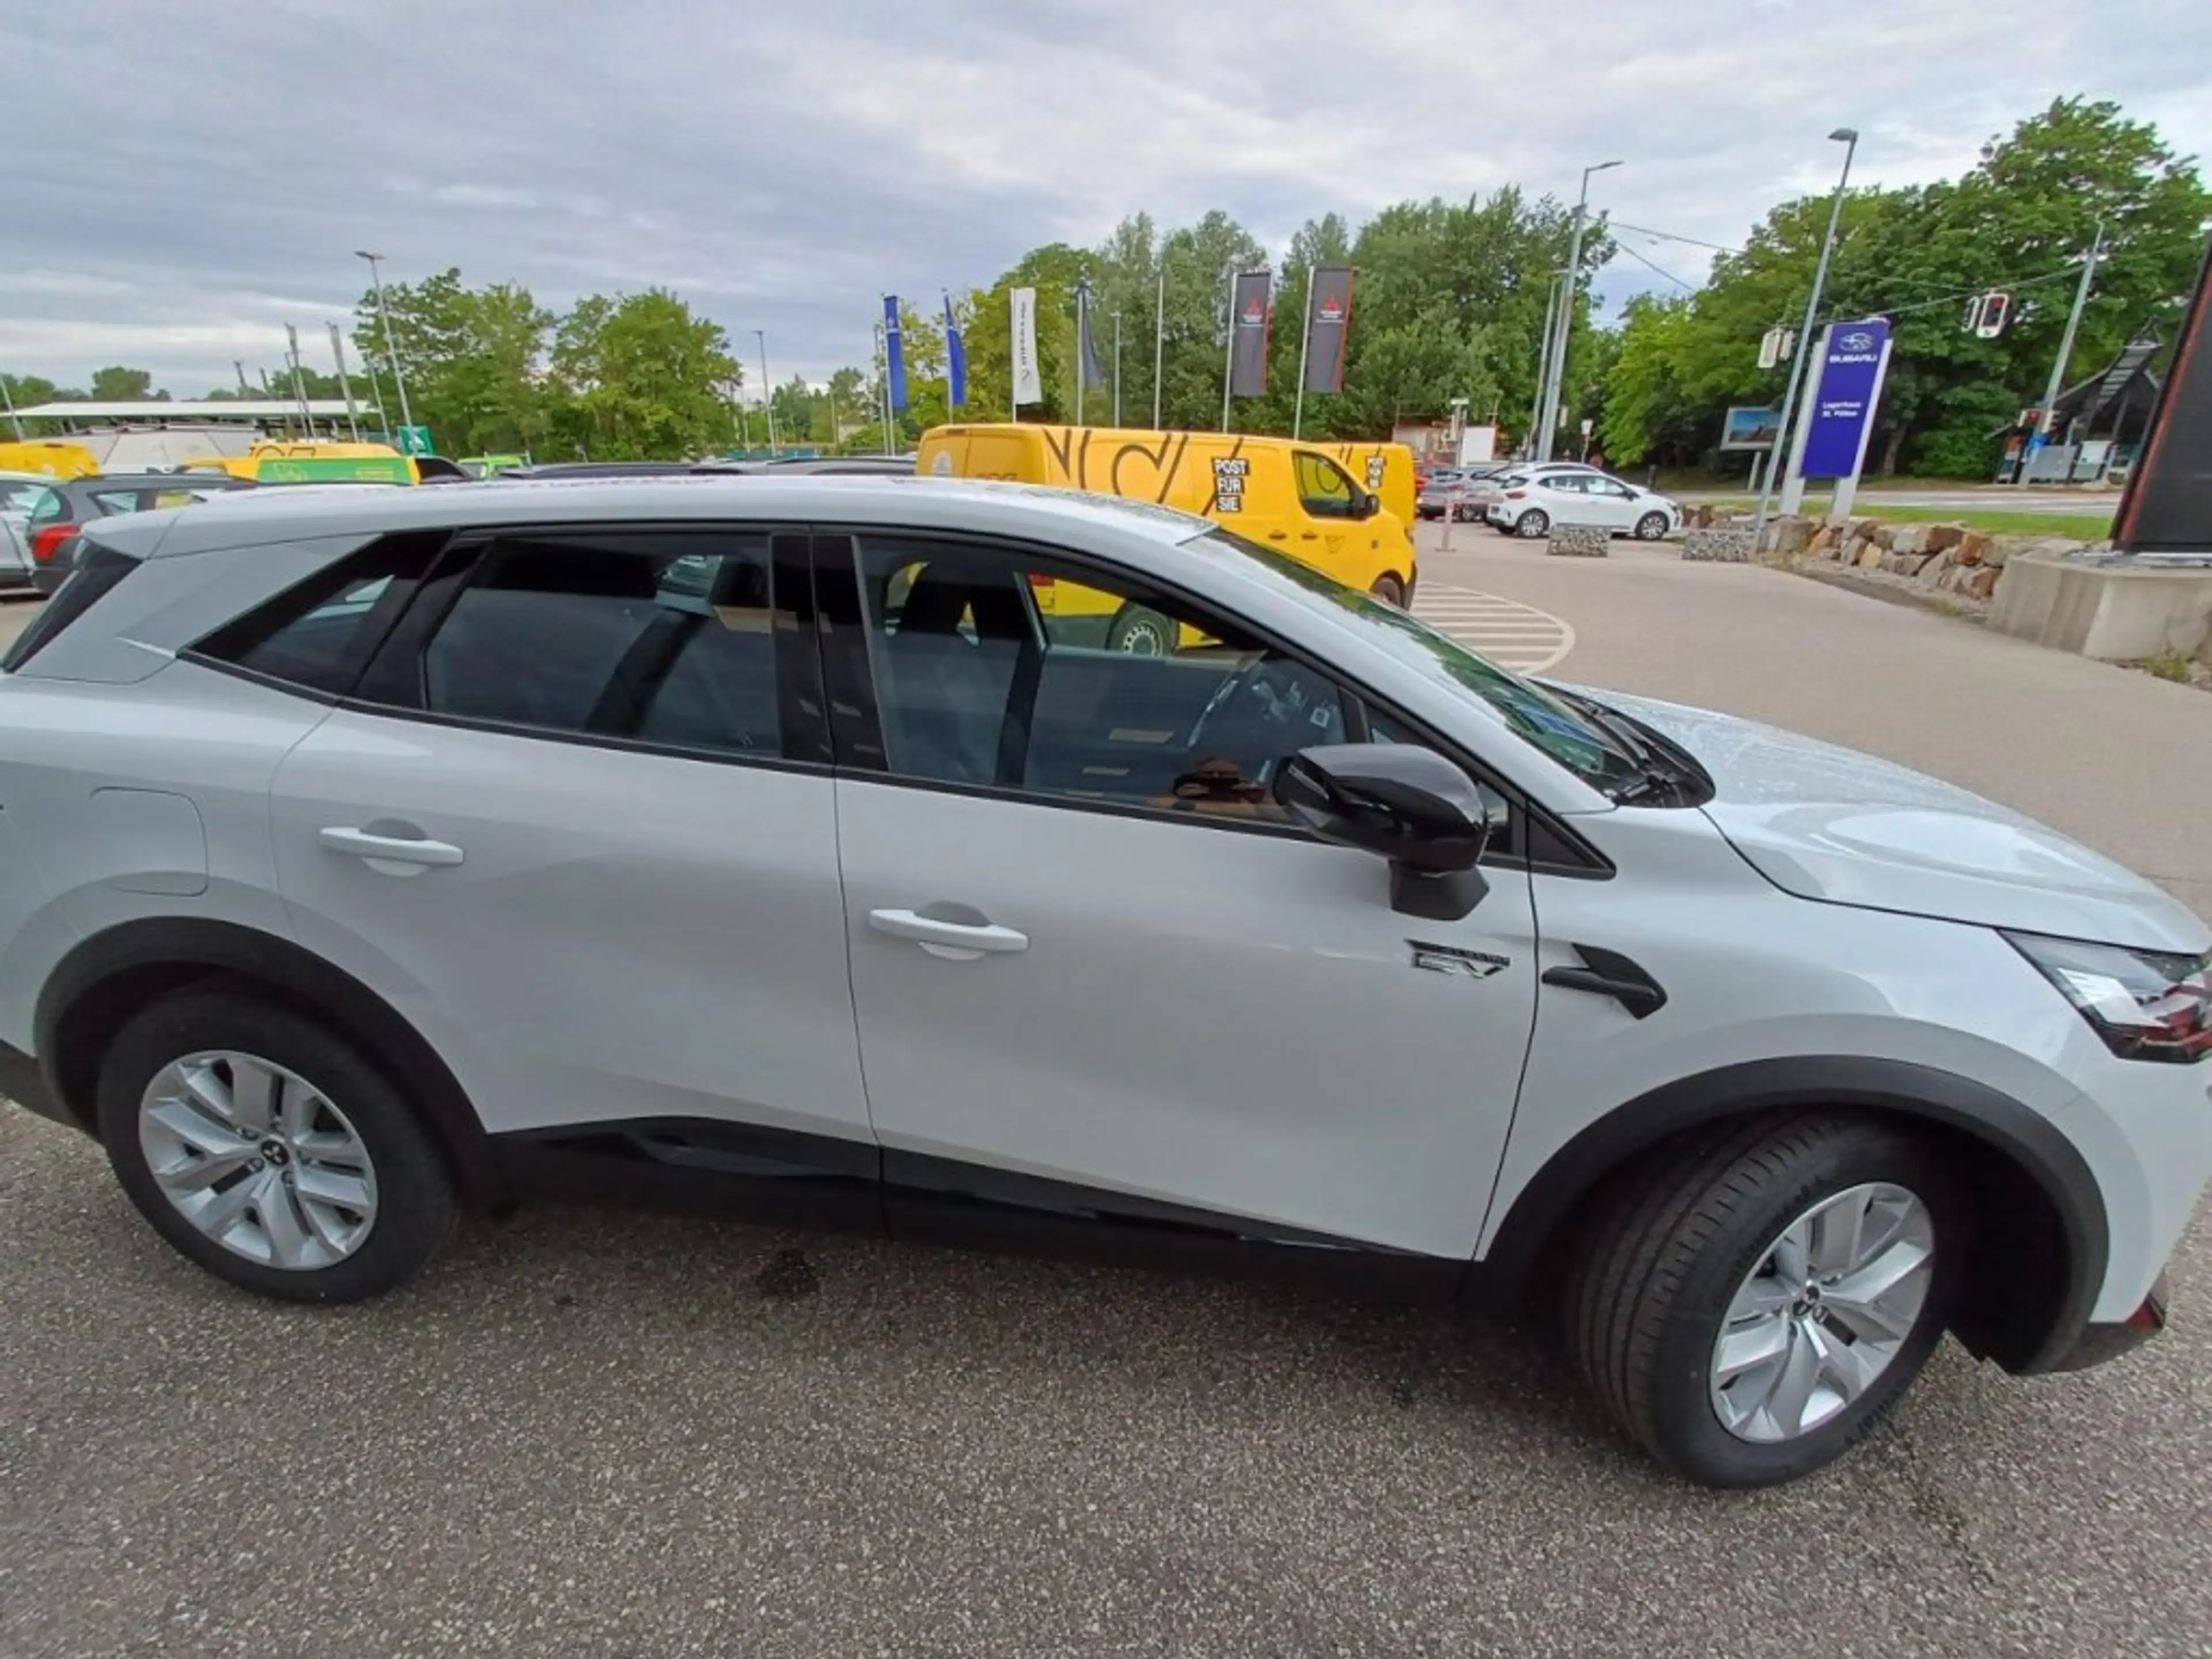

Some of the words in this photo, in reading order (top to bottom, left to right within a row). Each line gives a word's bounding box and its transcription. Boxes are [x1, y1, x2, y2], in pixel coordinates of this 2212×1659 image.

[1830, 354, 1877, 363] SUBARU
[1214, 459, 1245, 475] POST
[1217, 476, 1241, 493] FÜR
[1218, 497, 1238, 511] SIE
